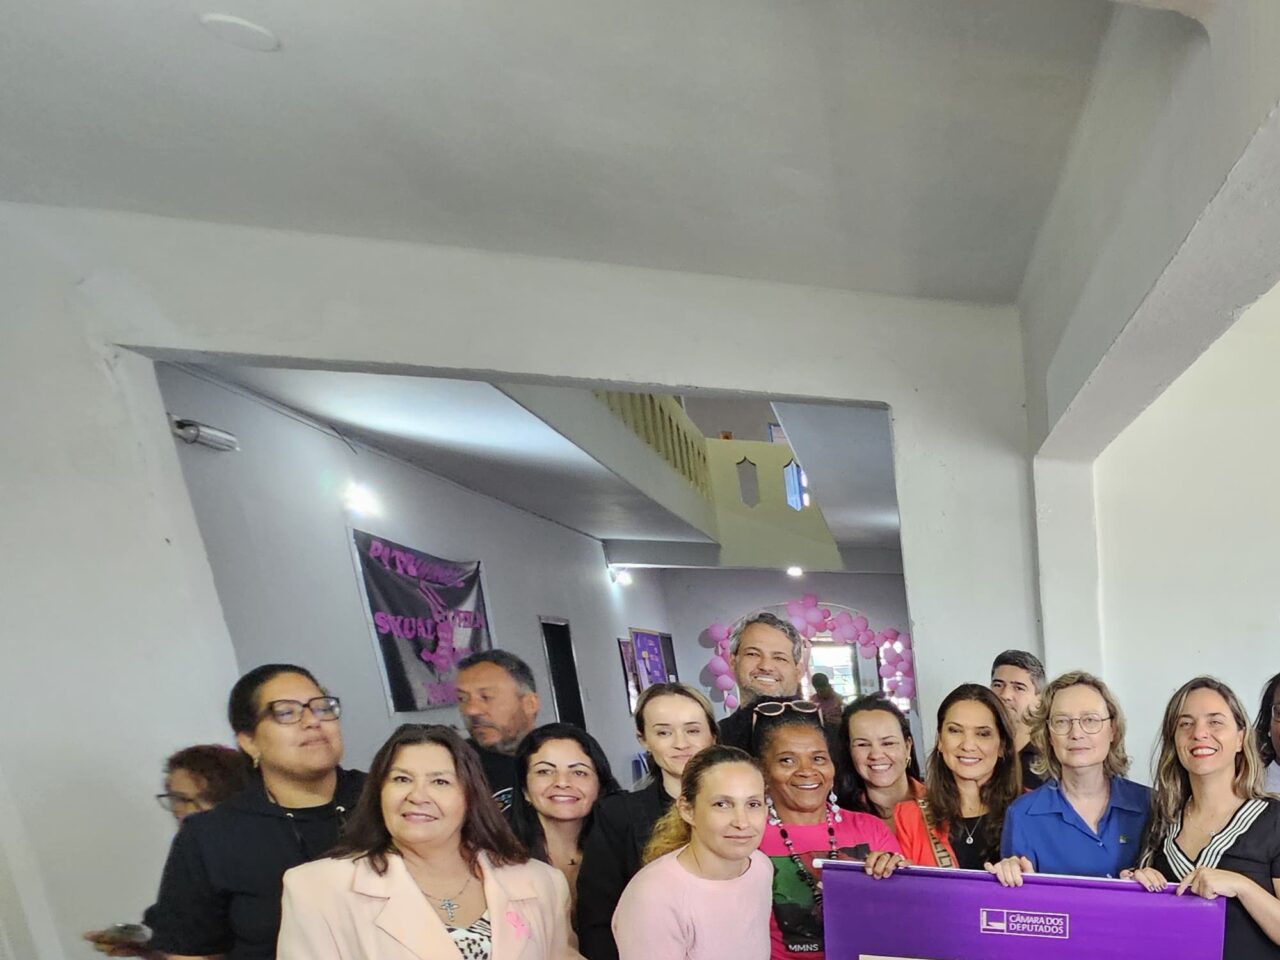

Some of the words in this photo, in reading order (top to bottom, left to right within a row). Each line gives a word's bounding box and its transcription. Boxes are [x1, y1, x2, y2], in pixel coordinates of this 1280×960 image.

[1009, 913, 1045, 924] CÂMARA
[1046, 917, 1064, 926] DOS
[1009, 923, 1064, 934] DEPUTADOS
